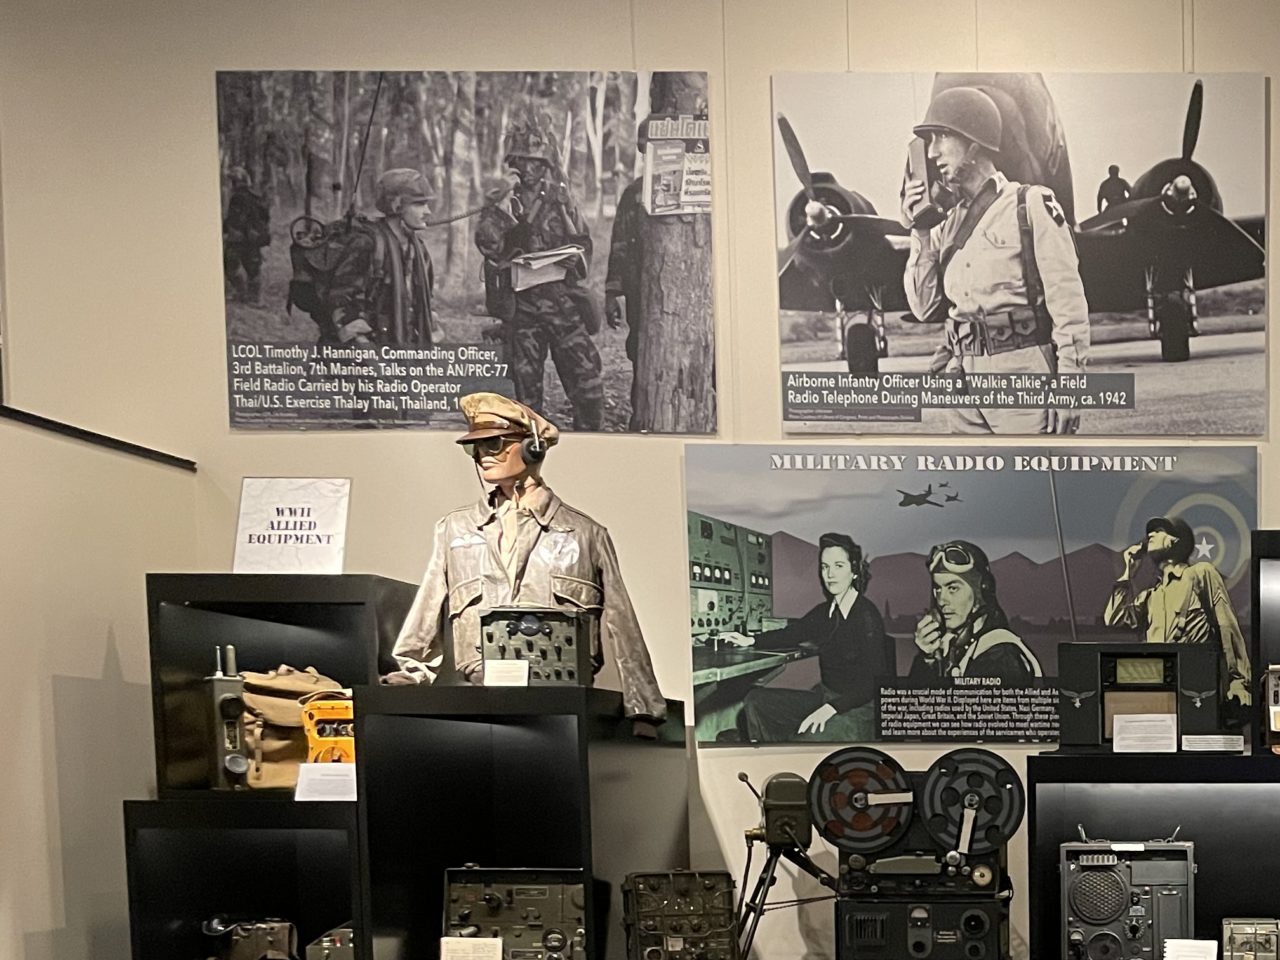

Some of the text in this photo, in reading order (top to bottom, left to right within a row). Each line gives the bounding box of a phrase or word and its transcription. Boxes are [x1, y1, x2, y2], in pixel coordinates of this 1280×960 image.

[232, 346, 498, 362] LCOL Timothy J. Hannigan, Commanding Officer,
[233, 363, 508, 377] 3rd Battalion, 7th Marines, Talks on the AN/PRC-77
[234, 379, 461, 396] Field Radio Carried by his Radio Operator
[787, 375, 836, 387] Airborne
[838, 375, 880, 390] Infantry
[882, 375, 920, 387] Officer
[922, 376, 953, 391] Using
[956, 379, 962, 388] a
[1051, 380, 1057, 388] a
[1060, 376, 1086, 388] Field
[233, 395, 459, 411] Thai/U.S. Exercise Thalay Thai, Thailand, 1
[788, 391, 1126, 407] Radio Telephone During Maneuvers of the Third Army, ca. 1942
[770, 455, 1177, 471] MILITARY RADIO EQUIPMENT
[276, 507, 312, 517] WWII
[266, 520, 317, 530] ALLIED
[248, 534, 334, 544] EQUIPMENT
